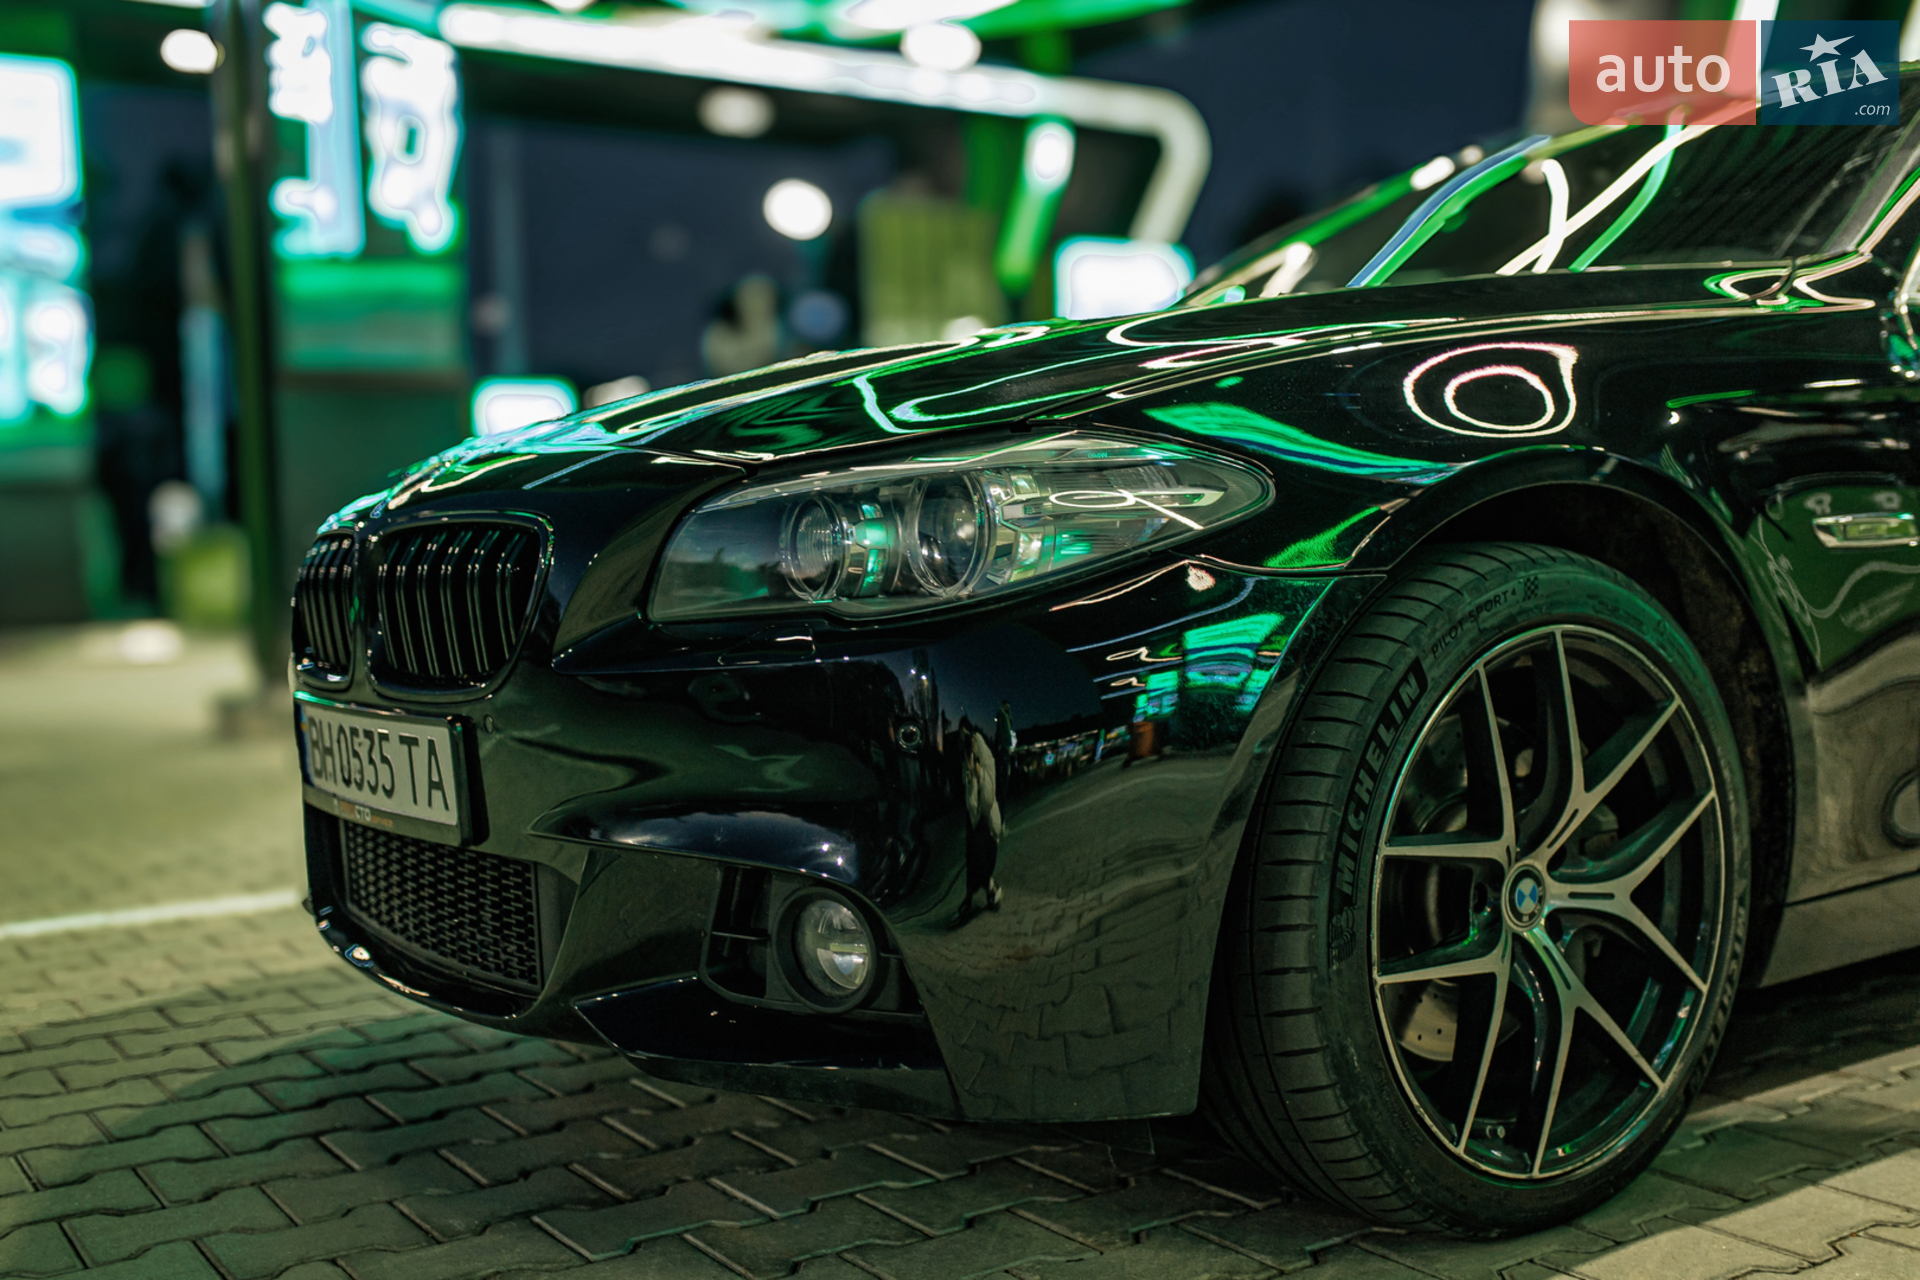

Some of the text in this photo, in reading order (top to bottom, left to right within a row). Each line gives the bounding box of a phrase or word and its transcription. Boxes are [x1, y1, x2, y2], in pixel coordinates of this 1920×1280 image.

[1431, 620, 1466, 658] PILOT
[1469, 590, 1509, 622] SPORT
[398, 732, 449, 811] TA
[1336, 666, 1421, 896] MICHELIN
